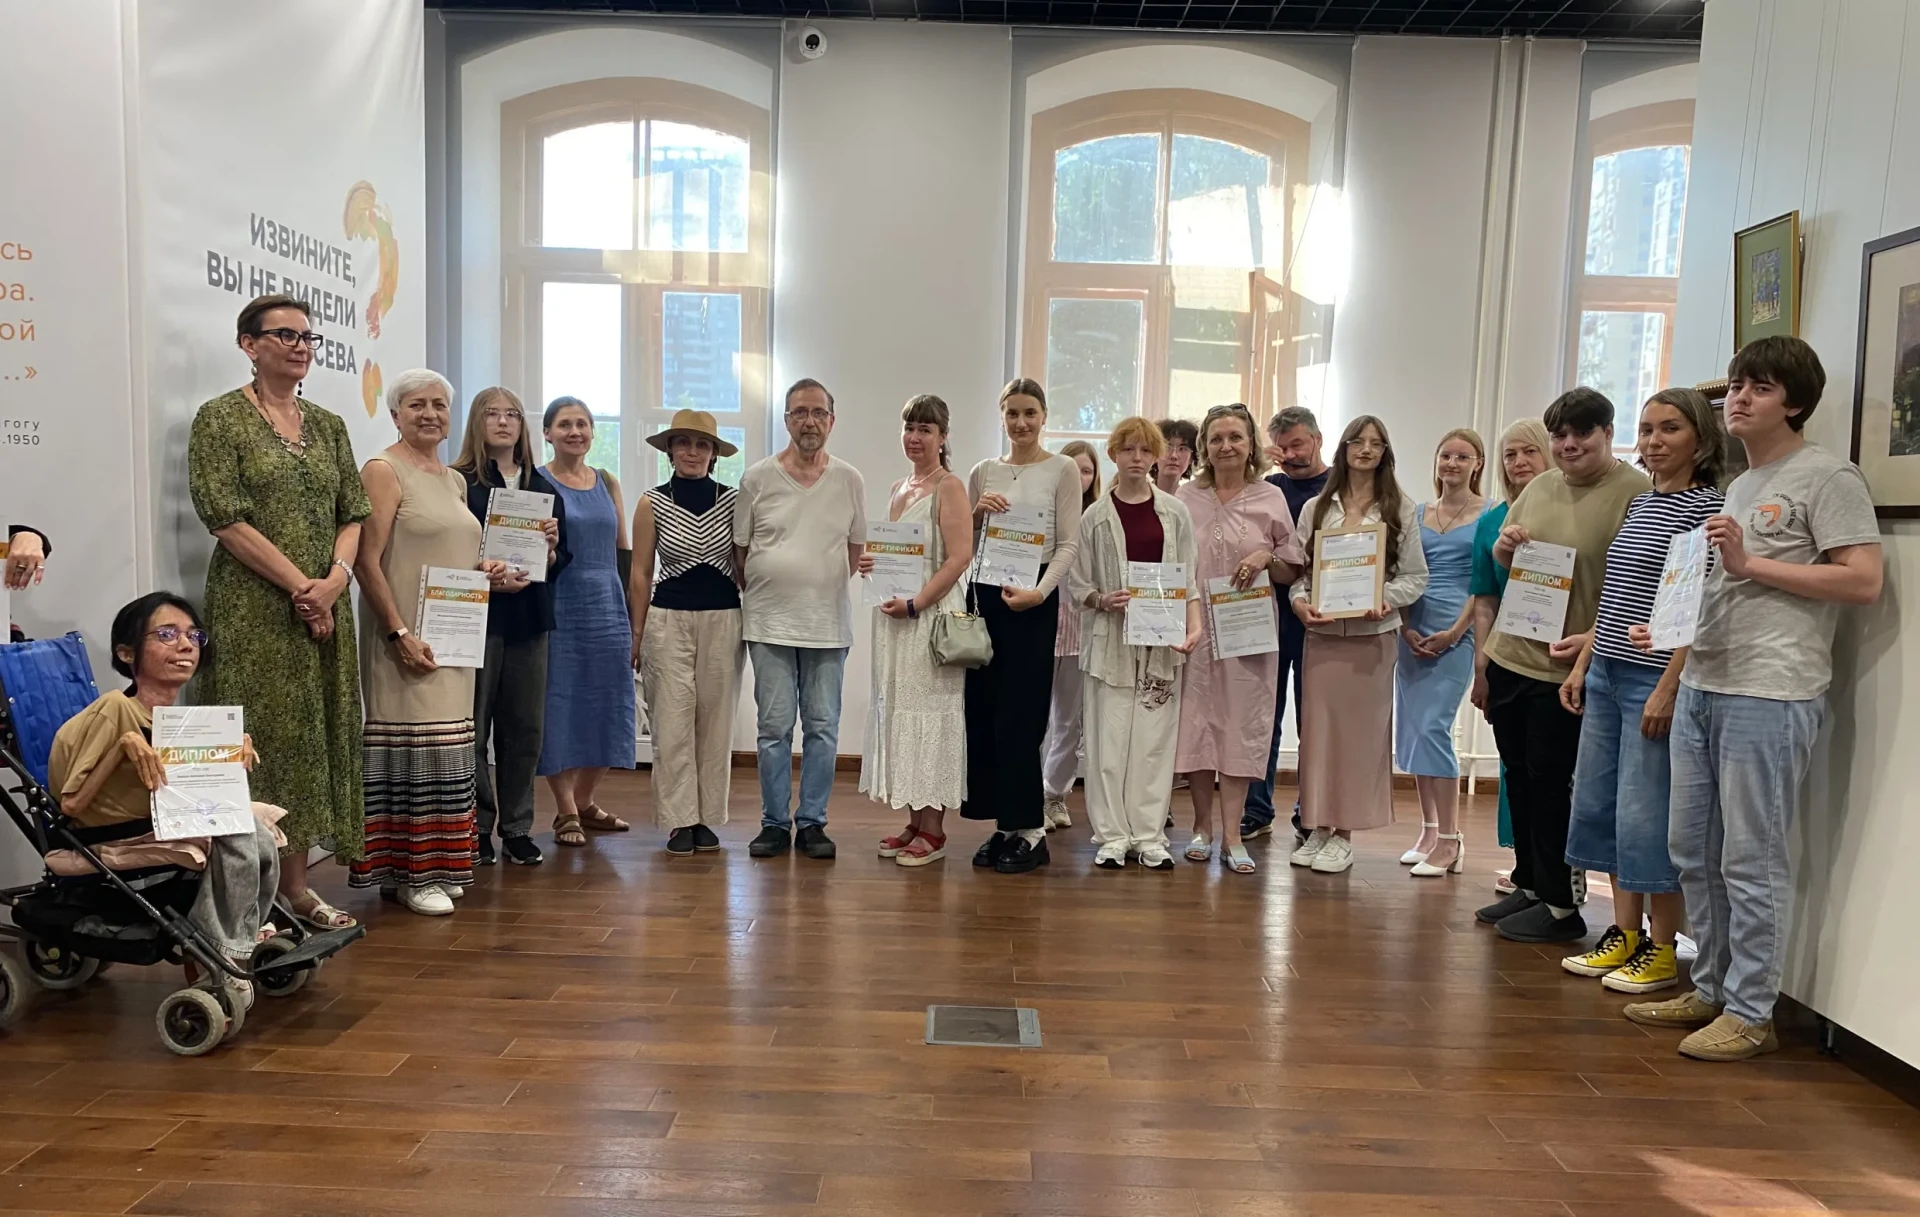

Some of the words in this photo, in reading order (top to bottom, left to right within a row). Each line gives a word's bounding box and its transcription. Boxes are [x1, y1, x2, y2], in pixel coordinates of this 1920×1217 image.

[251, 213, 356, 288] ИЗВИНИТЕ,
[207, 250, 243, 295] ВЫ
[250, 265, 277, 299] НЕ
[283, 277, 356, 329] ВИДЕЛИ
[0, 420, 40, 431] гогу
[499, 517, 540, 529] ДИПЛОМ
[996, 529, 1035, 543] ДИПЛОМ
[870, 543, 920, 553] СЕРТИФИКАТ
[1329, 557, 1368, 568] ДИПЛОМ
[1520, 571, 1561, 587] ДИПЛОМ
[430, 589, 483, 600] БЛАГОДАРНОСТЬ
[169, 748, 229, 762] ДИПЛОМ
